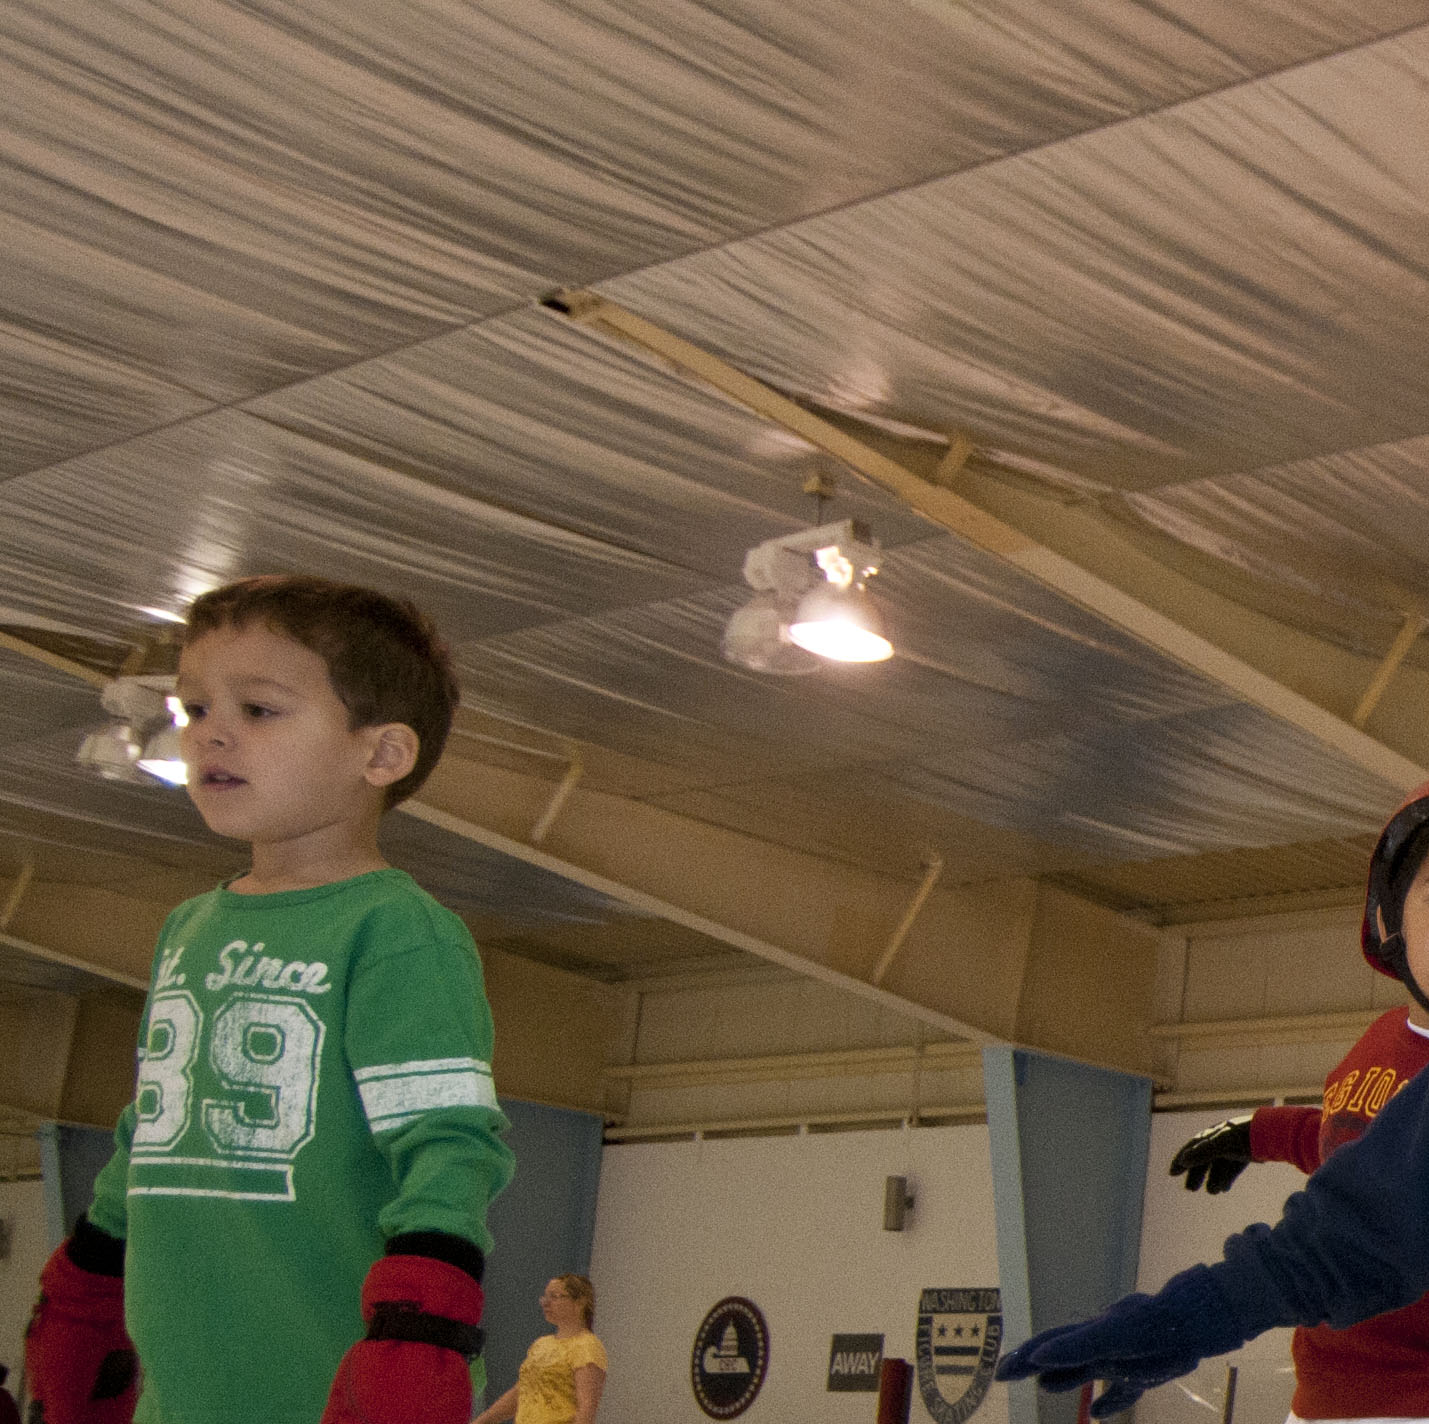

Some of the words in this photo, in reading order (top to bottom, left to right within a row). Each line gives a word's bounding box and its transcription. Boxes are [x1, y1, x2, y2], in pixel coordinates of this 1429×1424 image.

[205, 940, 332, 993] Since
[919, 1290, 1002, 1312] WASHINGTON
[830, 1351, 879, 1375] AWAY
